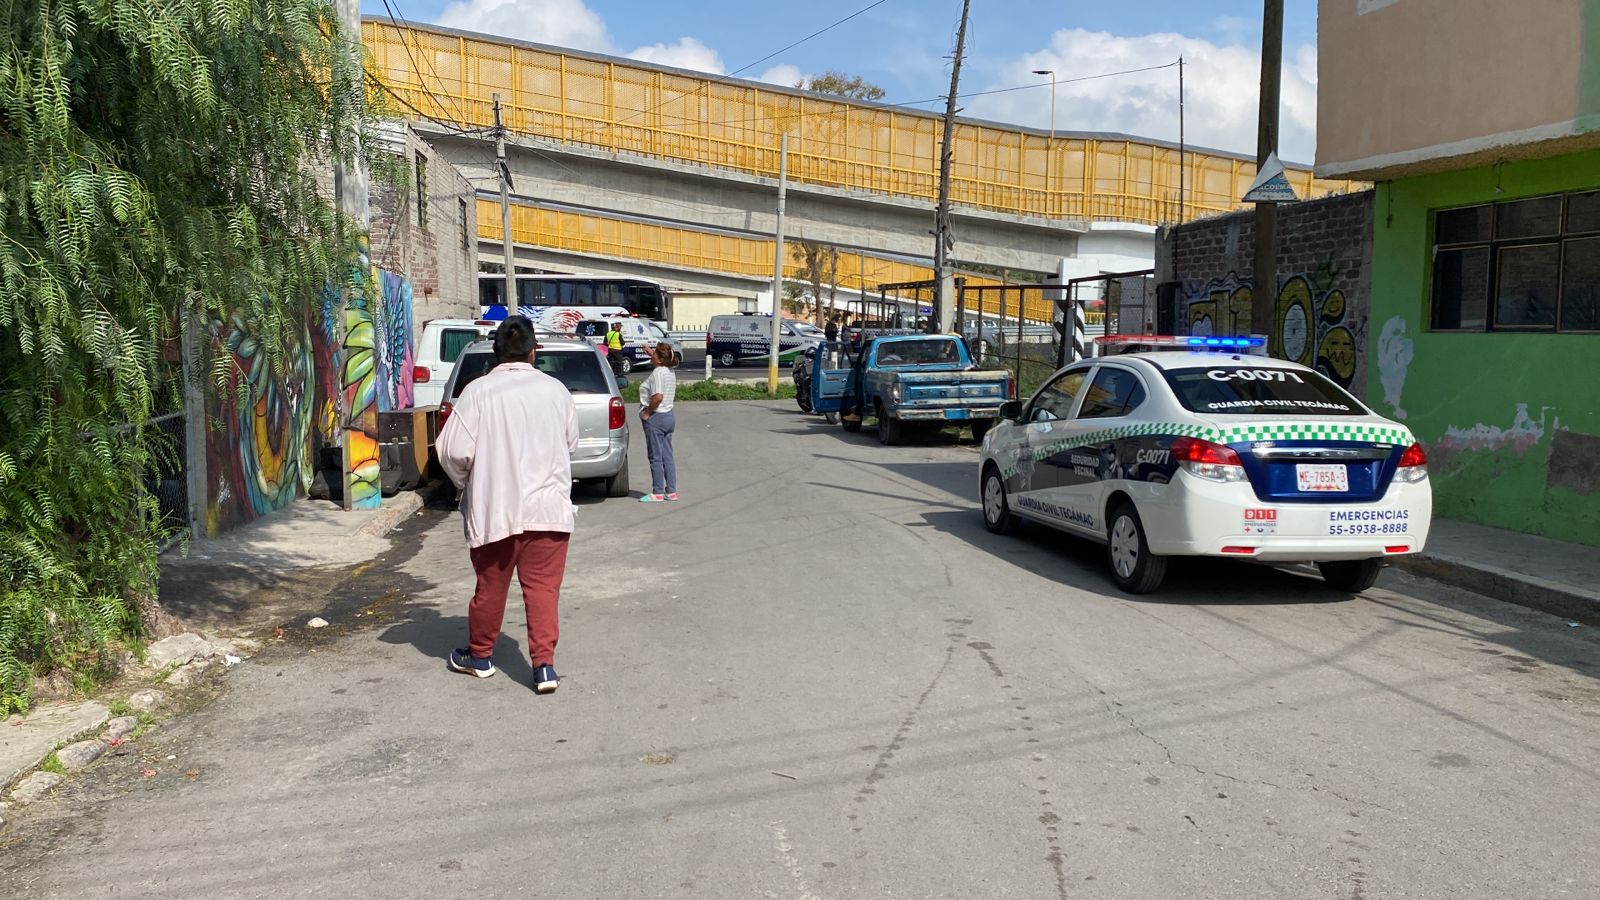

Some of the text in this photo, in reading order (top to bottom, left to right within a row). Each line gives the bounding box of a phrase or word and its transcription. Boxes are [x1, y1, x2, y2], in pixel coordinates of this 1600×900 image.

[1207, 369, 1304, 384] C-0071
[1208, 400, 1263, 409] GUARDIA
[1295, 400, 1350, 411] TECÁMAC
[1071, 454, 1100, 467] SEGURIDAD
[1136, 449, 1170, 464] C-0071
[1017, 495, 1094, 526] GUARDIA CIVIL TECÁMAC
[1246, 509, 1275, 519] 911
[1330, 510, 1409, 521] EMERGENCIAS
[1329, 523, 1408, 535] 55-5938-8888
